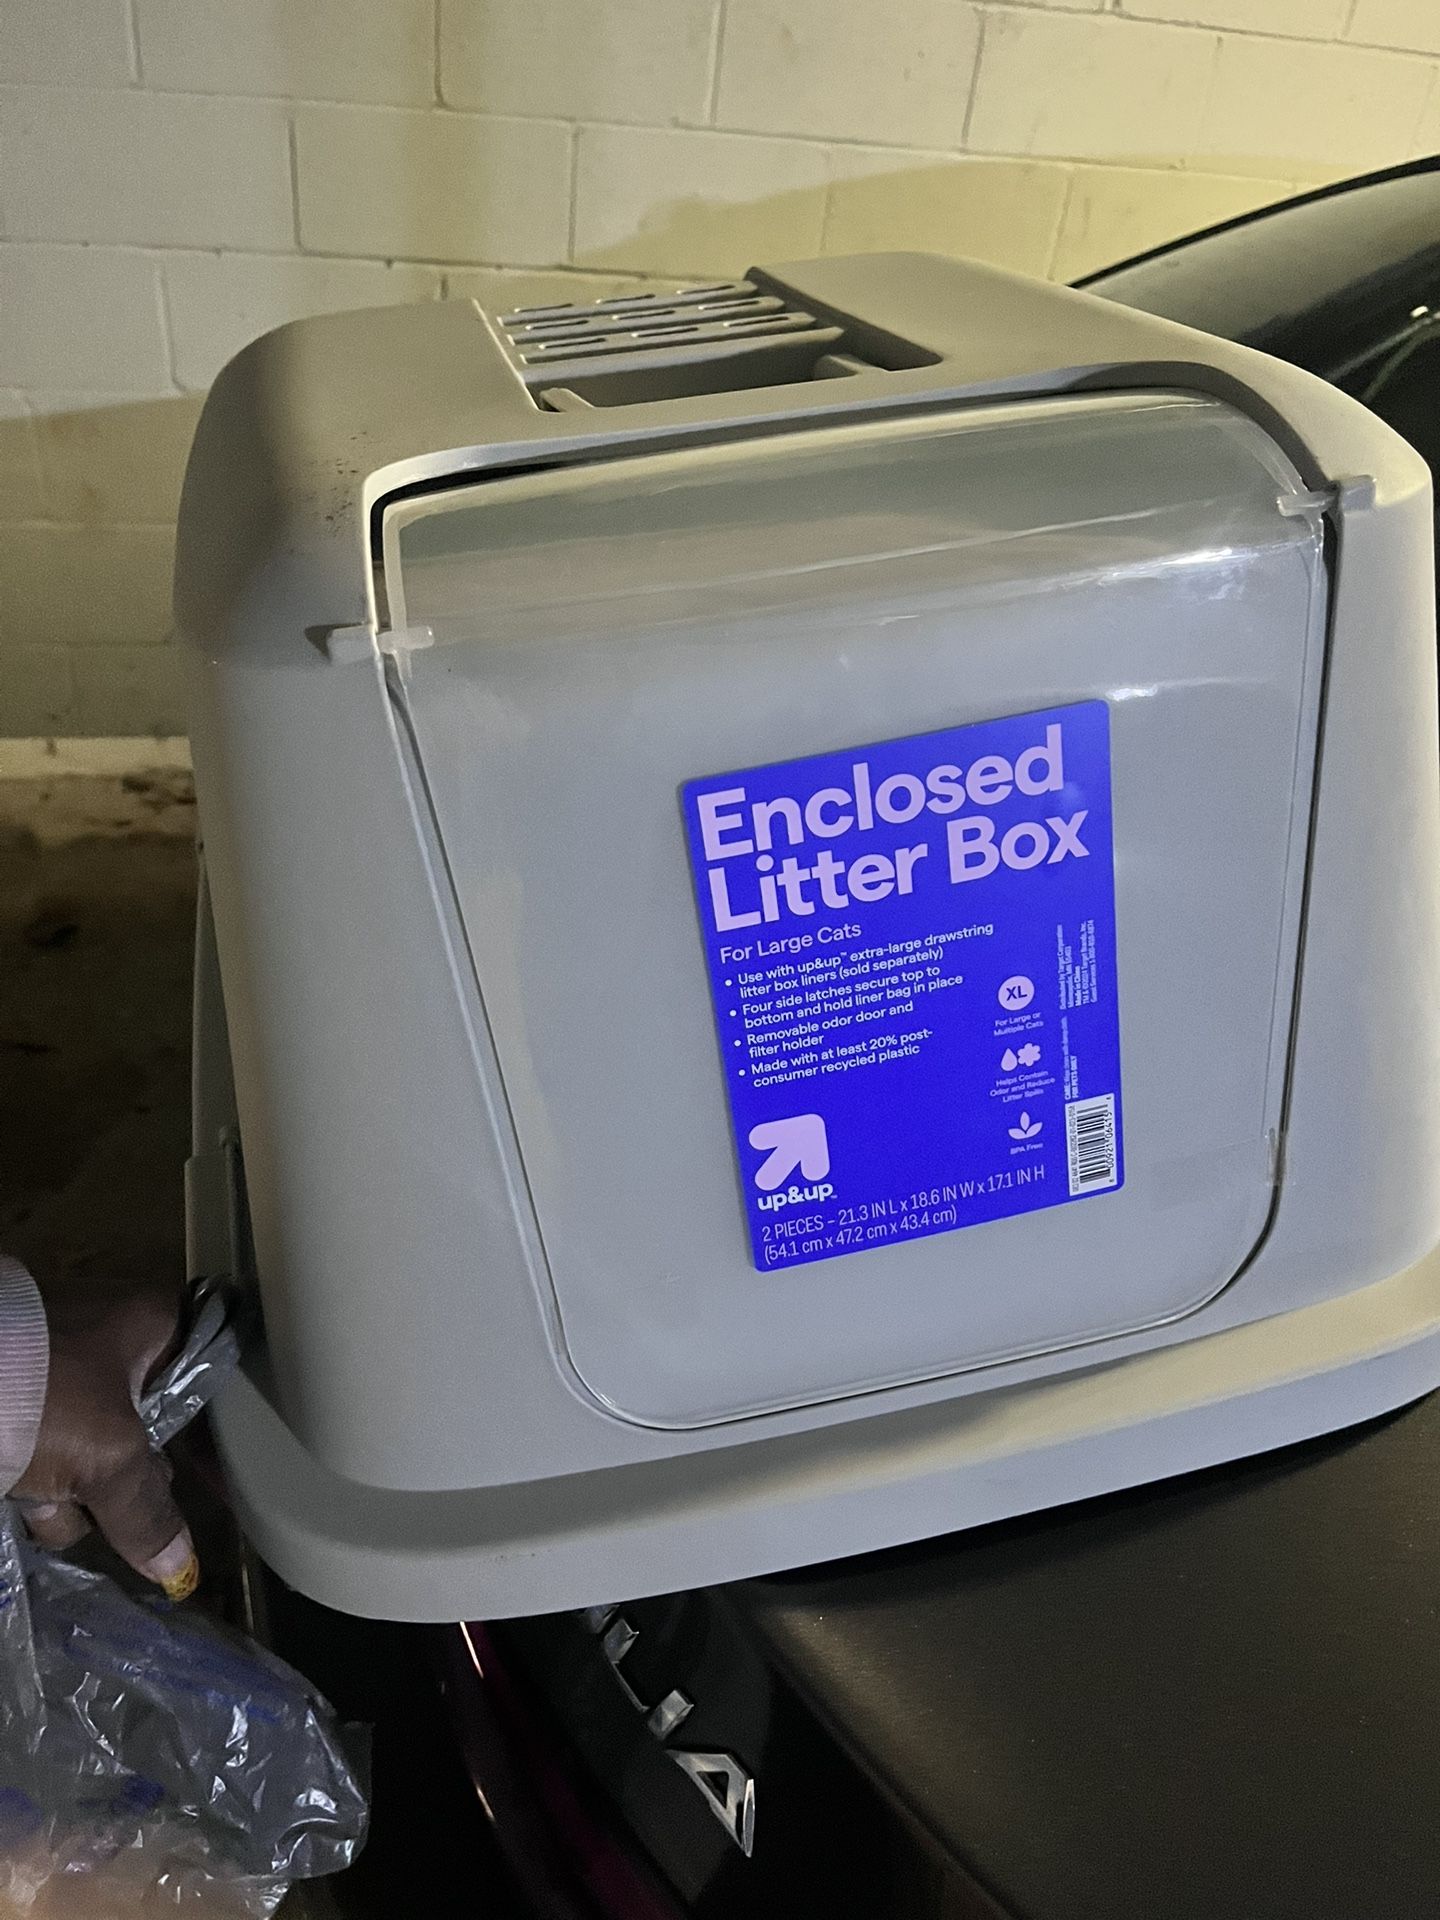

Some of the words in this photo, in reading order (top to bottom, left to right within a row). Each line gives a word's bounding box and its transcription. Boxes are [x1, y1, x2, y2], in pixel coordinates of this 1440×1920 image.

[696, 723, 1065, 862] Enclosed
[707, 842, 929, 933] Litter
[946, 810, 1090, 884] Box
[719, 946, 753, 964] For
[756, 934, 814, 957] Large
[817, 923, 862, 944] Cats
[737, 972, 764, 985] Use
[765, 964, 795, 979] with
[849, 939, 922, 962] extra-large
[924, 923, 994, 948] drawstring
[739, 984, 772, 999] litter
[773, 979, 799, 992] box
[800, 971, 837, 987] liners
[838, 961, 870, 980] (sold
[872, 945, 944, 971] separately)
[742, 1001, 773, 1016] Four
[775, 994, 803, 1009] side
[805, 985, 853, 1003] latches
[854, 975, 900, 992] secure
[901, 970, 924, 982] top
[925, 966, 941, 977] to
[1006, 984, 1027, 1001] XL
[744, 1011, 794, 1029] bottom
[796, 1002, 822, 1018] and
[823, 996, 853, 1013] hold
[855, 992, 884, 1006] liner
[886, 986, 911, 1000] bag
[913, 981, 926, 994] in
[927, 975, 963, 993] place
[746, 1021, 820, 1046] Removable
[821, 1015, 853, 1030] odor
[855, 1008, 887, 1023] door
[888, 1000, 914, 1016] and
[994, 1019, 1009, 1027] For
[1008, 1014, 1032, 1025] Large
[748, 1044, 780, 1059] filter
[782, 1035, 825, 1052] holder
[993, 1024, 1025, 1037] Multiple
[1025, 1020, 1044, 1030] Cats
[751, 1058, 788, 1075] Made
[790, 1051, 819, 1067] with
[820, 1048, 835, 1061] at
[836, 1041, 868, 1058] least
[869, 1034, 898, 1050] 20%
[753, 1066, 819, 1088] consumer
[820, 1051, 876, 1074] recycled
[878, 1043, 920, 1064] plastic
[757, 1183, 834, 1212] up&up
[761, 1225, 772, 1243] 2
[774, 1214, 824, 1240] PIECES
[838, 1204, 869, 1226] 21.3
[871, 1200, 887, 1219] IN
[888, 1199, 898, 1215] L
[910, 1188, 940, 1210] 18.6
[942, 1184, 958, 1202] IN
[959, 1180, 975, 1198] W
[1016, 1167, 1031, 1185] IN
[1033, 1164, 1045, 1181] H
[764, 1240, 800, 1265] (54.1
[801, 1238, 824, 1254] cm
[835, 1225, 864, 1245] 47.2
[866, 1224, 888, 1240] cm
[899, 1211, 930, 1231] 43.4
[932, 1204, 957, 1225] cm)
